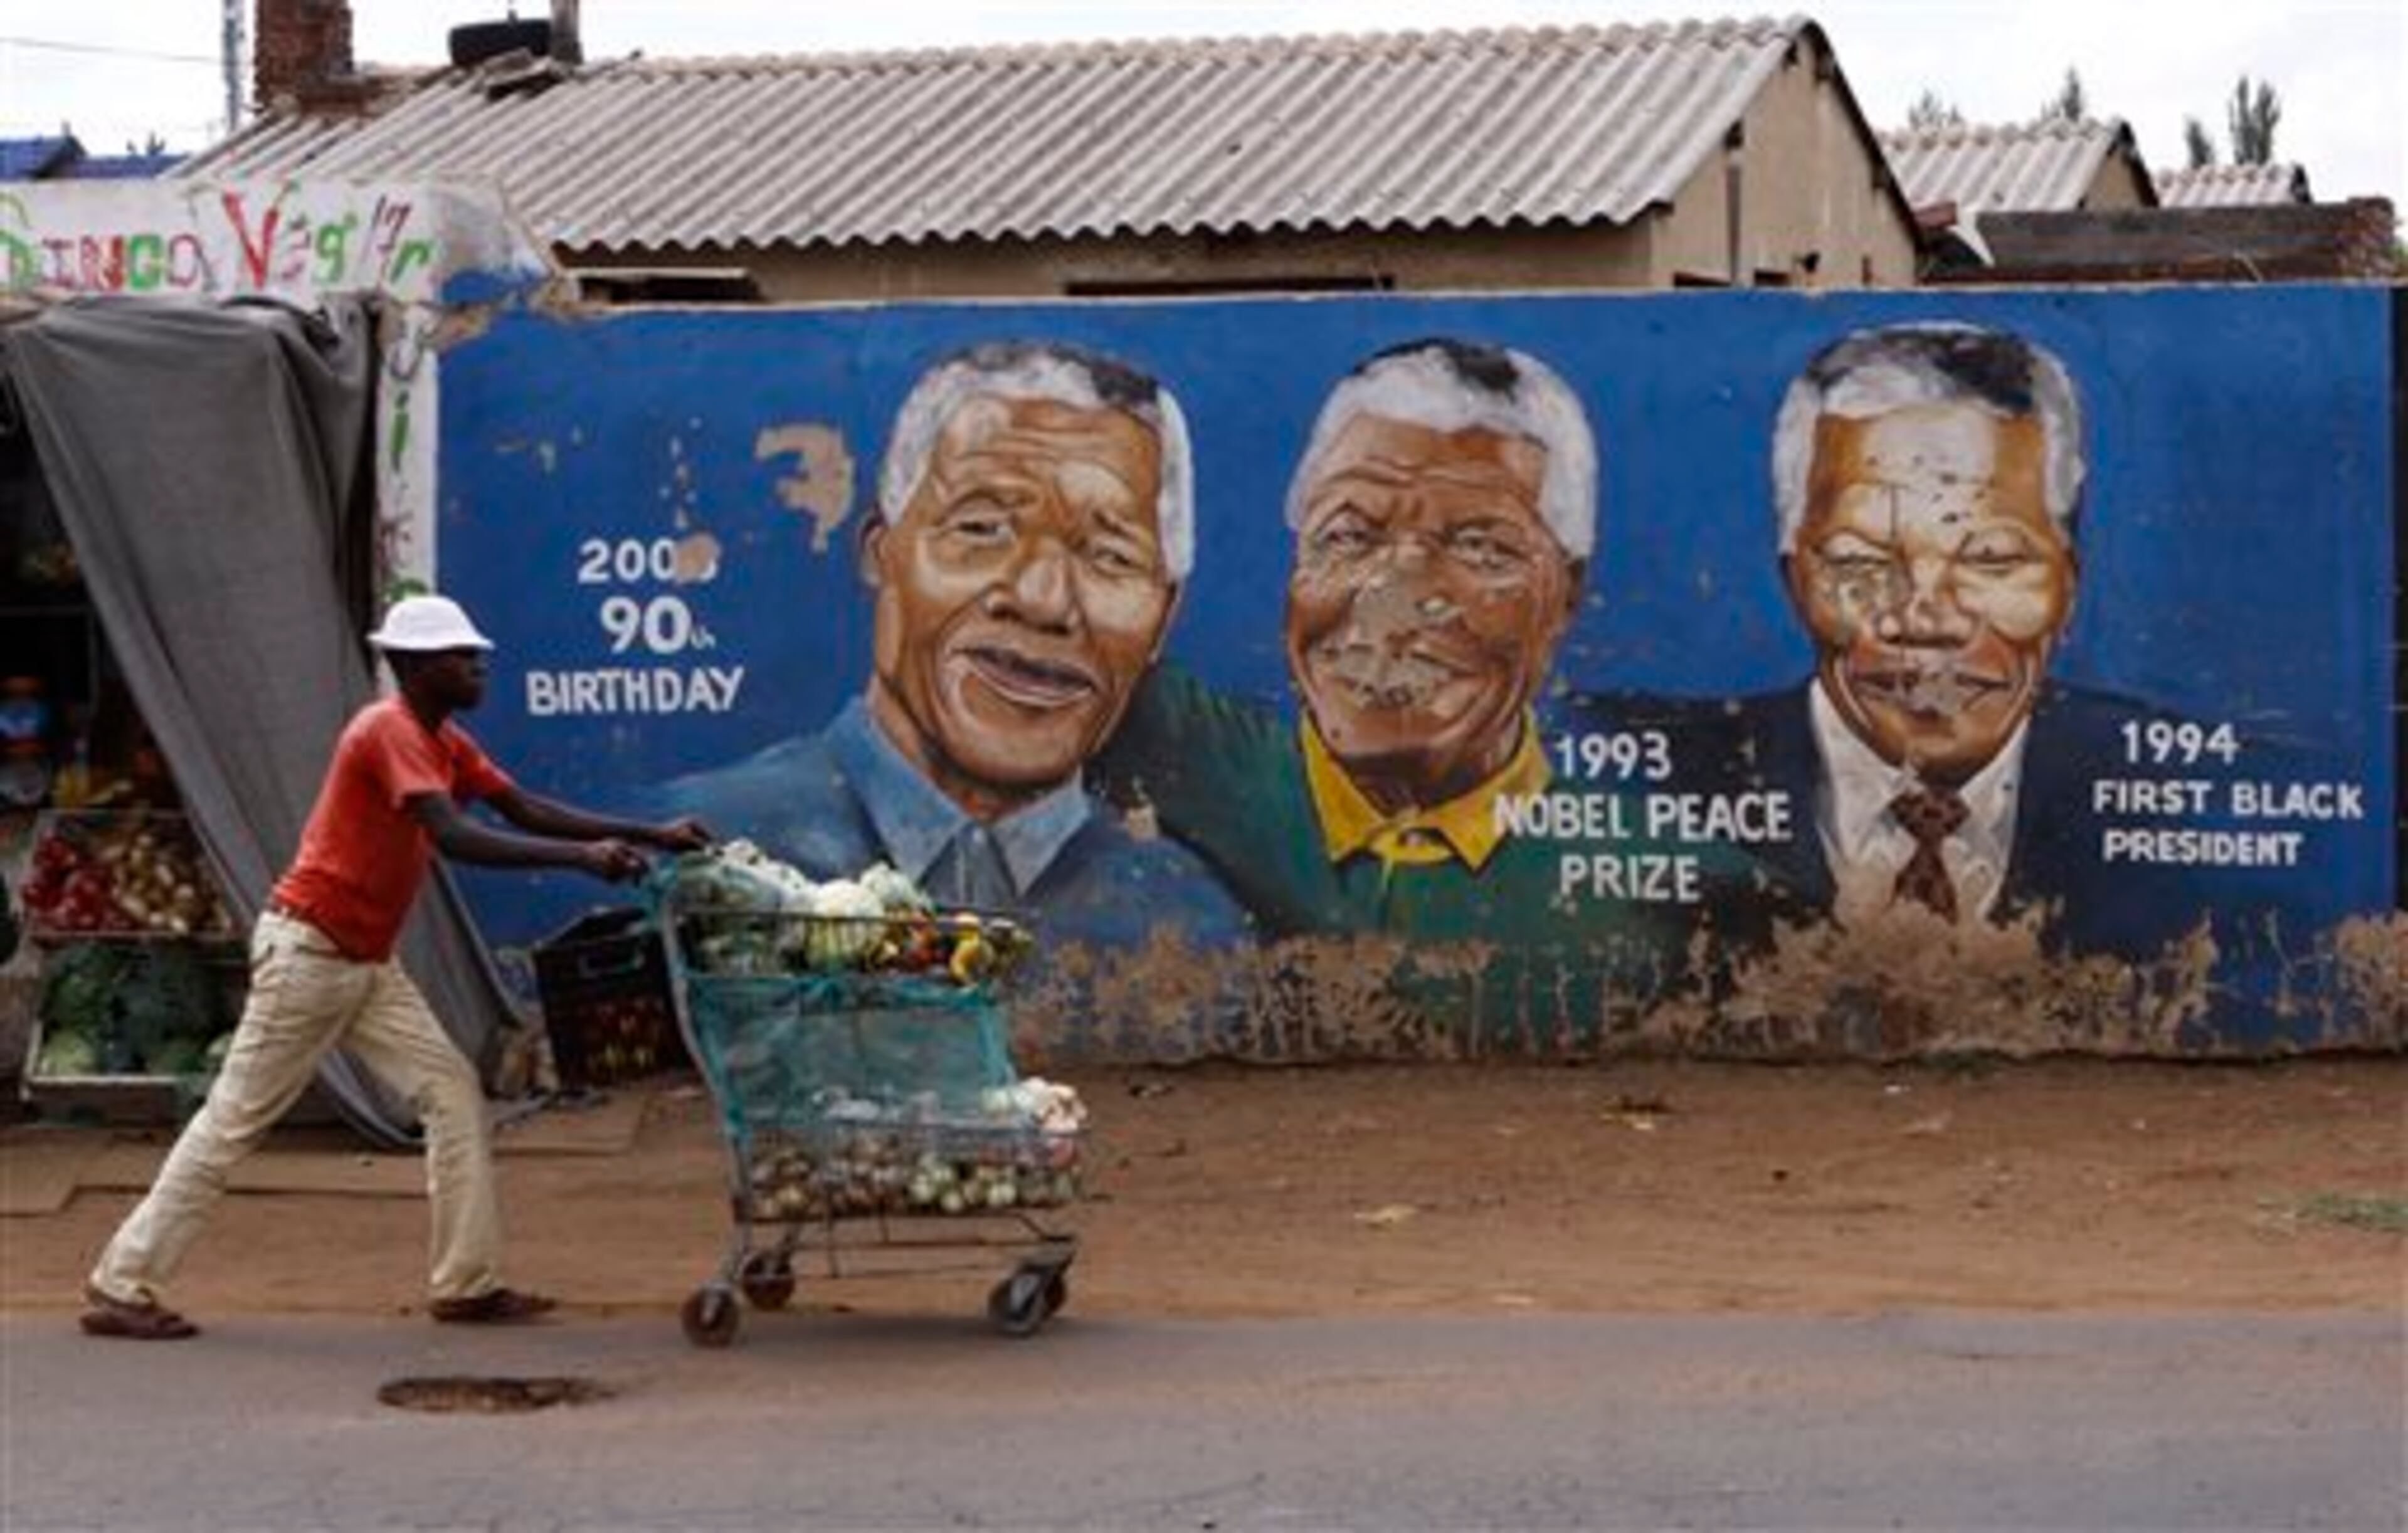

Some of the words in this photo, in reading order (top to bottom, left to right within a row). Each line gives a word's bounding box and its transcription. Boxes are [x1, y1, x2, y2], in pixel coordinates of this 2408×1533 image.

[578, 538, 719, 584] 200
[525, 666, 745, 716] BIRTHDAY
[1556, 731, 1672, 781] 1993
[2120, 720, 2240, 764] 1994
[1492, 793, 1630, 838] NOBEL
[1645, 793, 1793, 843] PEACE
[2093, 779, 2214, 815] FIRST
[2231, 782, 2364, 819] BLACK
[2103, 829, 2304, 866] PRESIDENT
[1560, 854, 1699, 902] PRIZE
